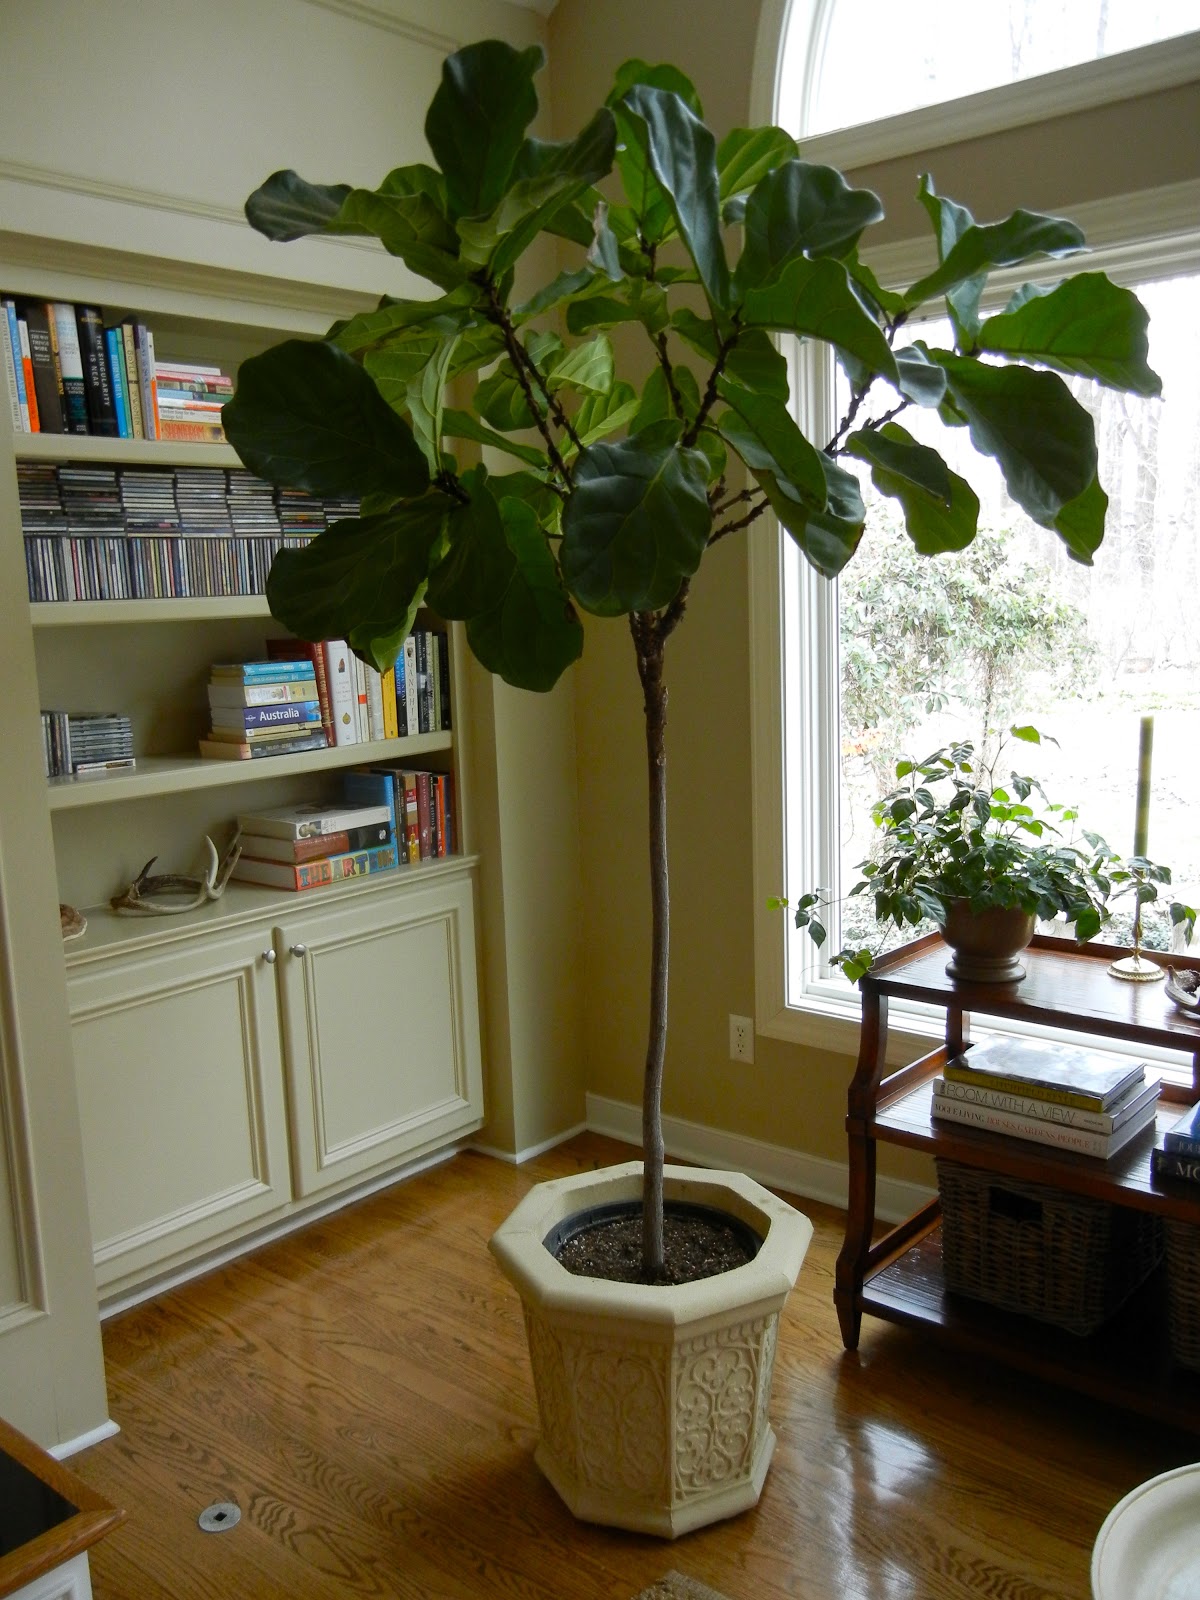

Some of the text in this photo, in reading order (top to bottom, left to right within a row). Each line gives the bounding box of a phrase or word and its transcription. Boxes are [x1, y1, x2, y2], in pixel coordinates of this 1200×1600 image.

[90, 354, 99, 386] IS NEAR
[127, 350, 135, 374] BOYLE
[98, 353, 110, 407] SINGULARITY
[407, 659, 415, 713] GANDHI
[260, 708, 299, 721] Australia
[299, 864, 330, 887] THE
[332, 854, 368, 880] ART
[935, 1103, 984, 1122] VOGUE LIVING
[946, 1084, 988, 1105] ROOM
[992, 1093, 1024, 1112] WITH
[1027, 1103, 1036, 1114] A
[1041, 1105, 1075, 1124] VIEW
[1057, 1135, 1090, 1149] PEOPLE
